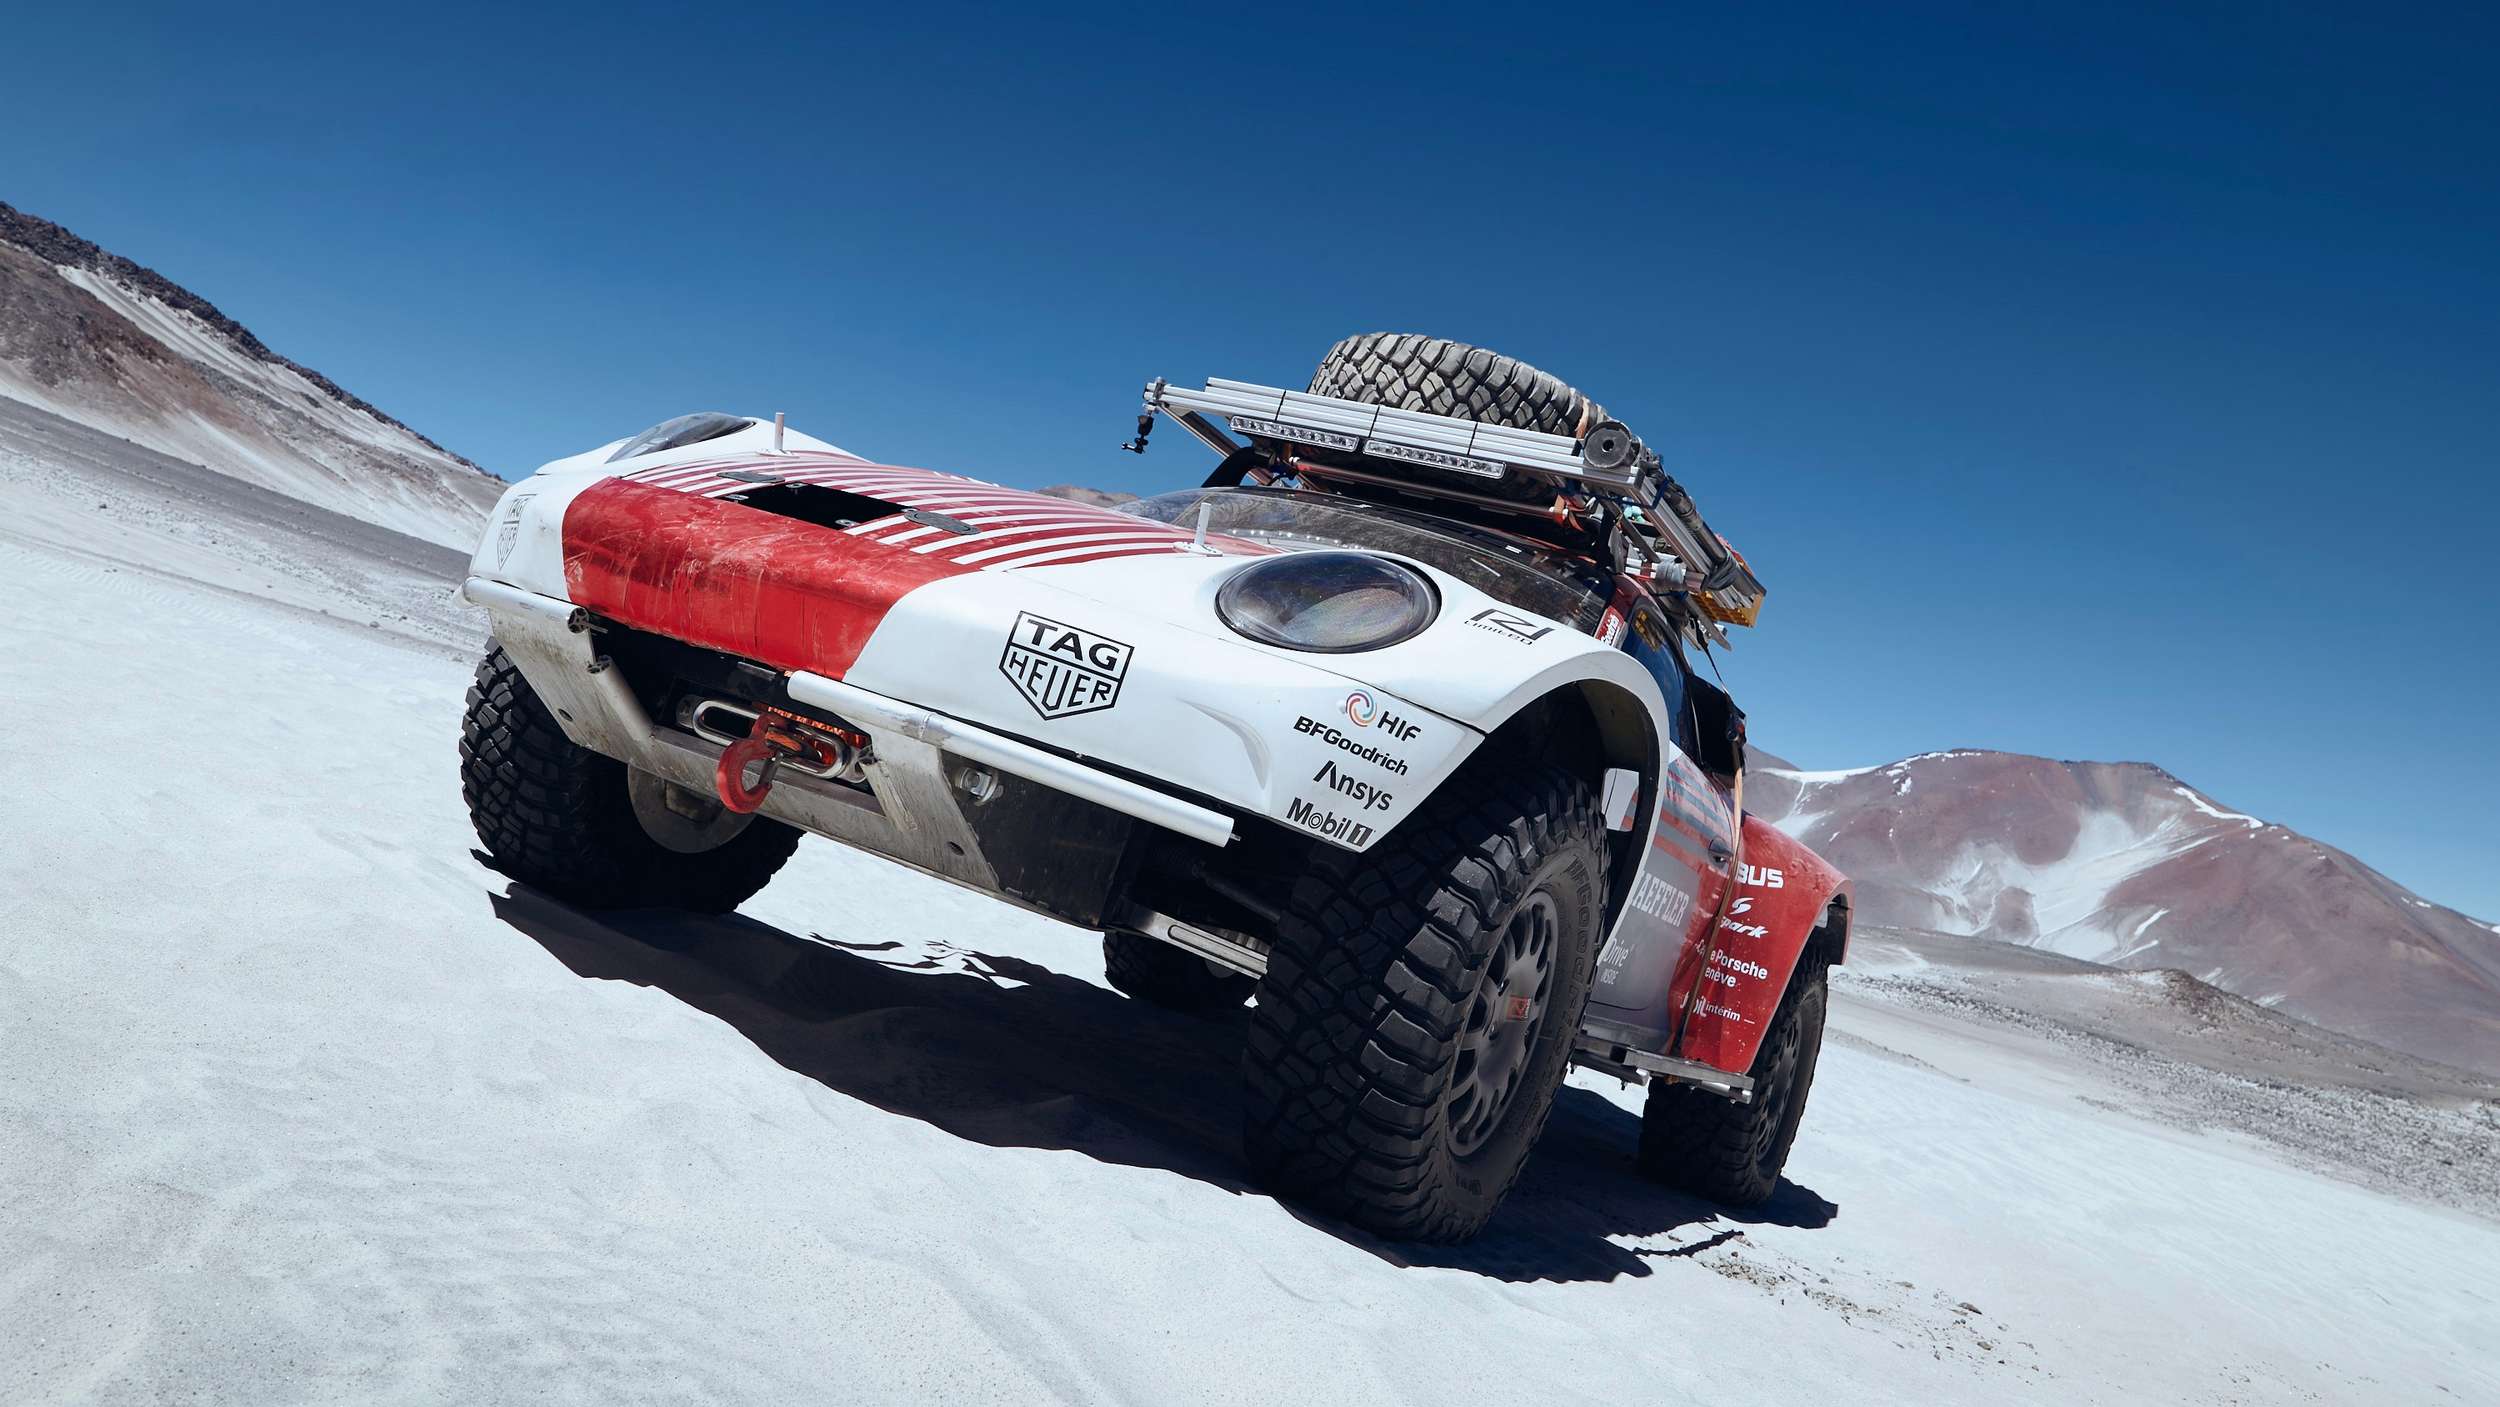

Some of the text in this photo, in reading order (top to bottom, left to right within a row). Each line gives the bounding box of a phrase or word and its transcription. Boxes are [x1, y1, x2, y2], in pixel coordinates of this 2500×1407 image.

[1027, 618, 1120, 672] TAG
[1008, 651, 1112, 711] HEUER
[1293, 716, 1409, 776] BFGoodrich
[1377, 711, 1421, 742] HIF
[1313, 760, 1393, 811] Ansys
[1286, 797, 1352, 840] Mobil
[1735, 861, 1784, 888] BUS
[1632, 871, 1690, 928] AEFFLER
[1720, 916, 1768, 939] park
[1704, 966, 1737, 988] enève
[1716, 949, 1768, 980] Porsche
